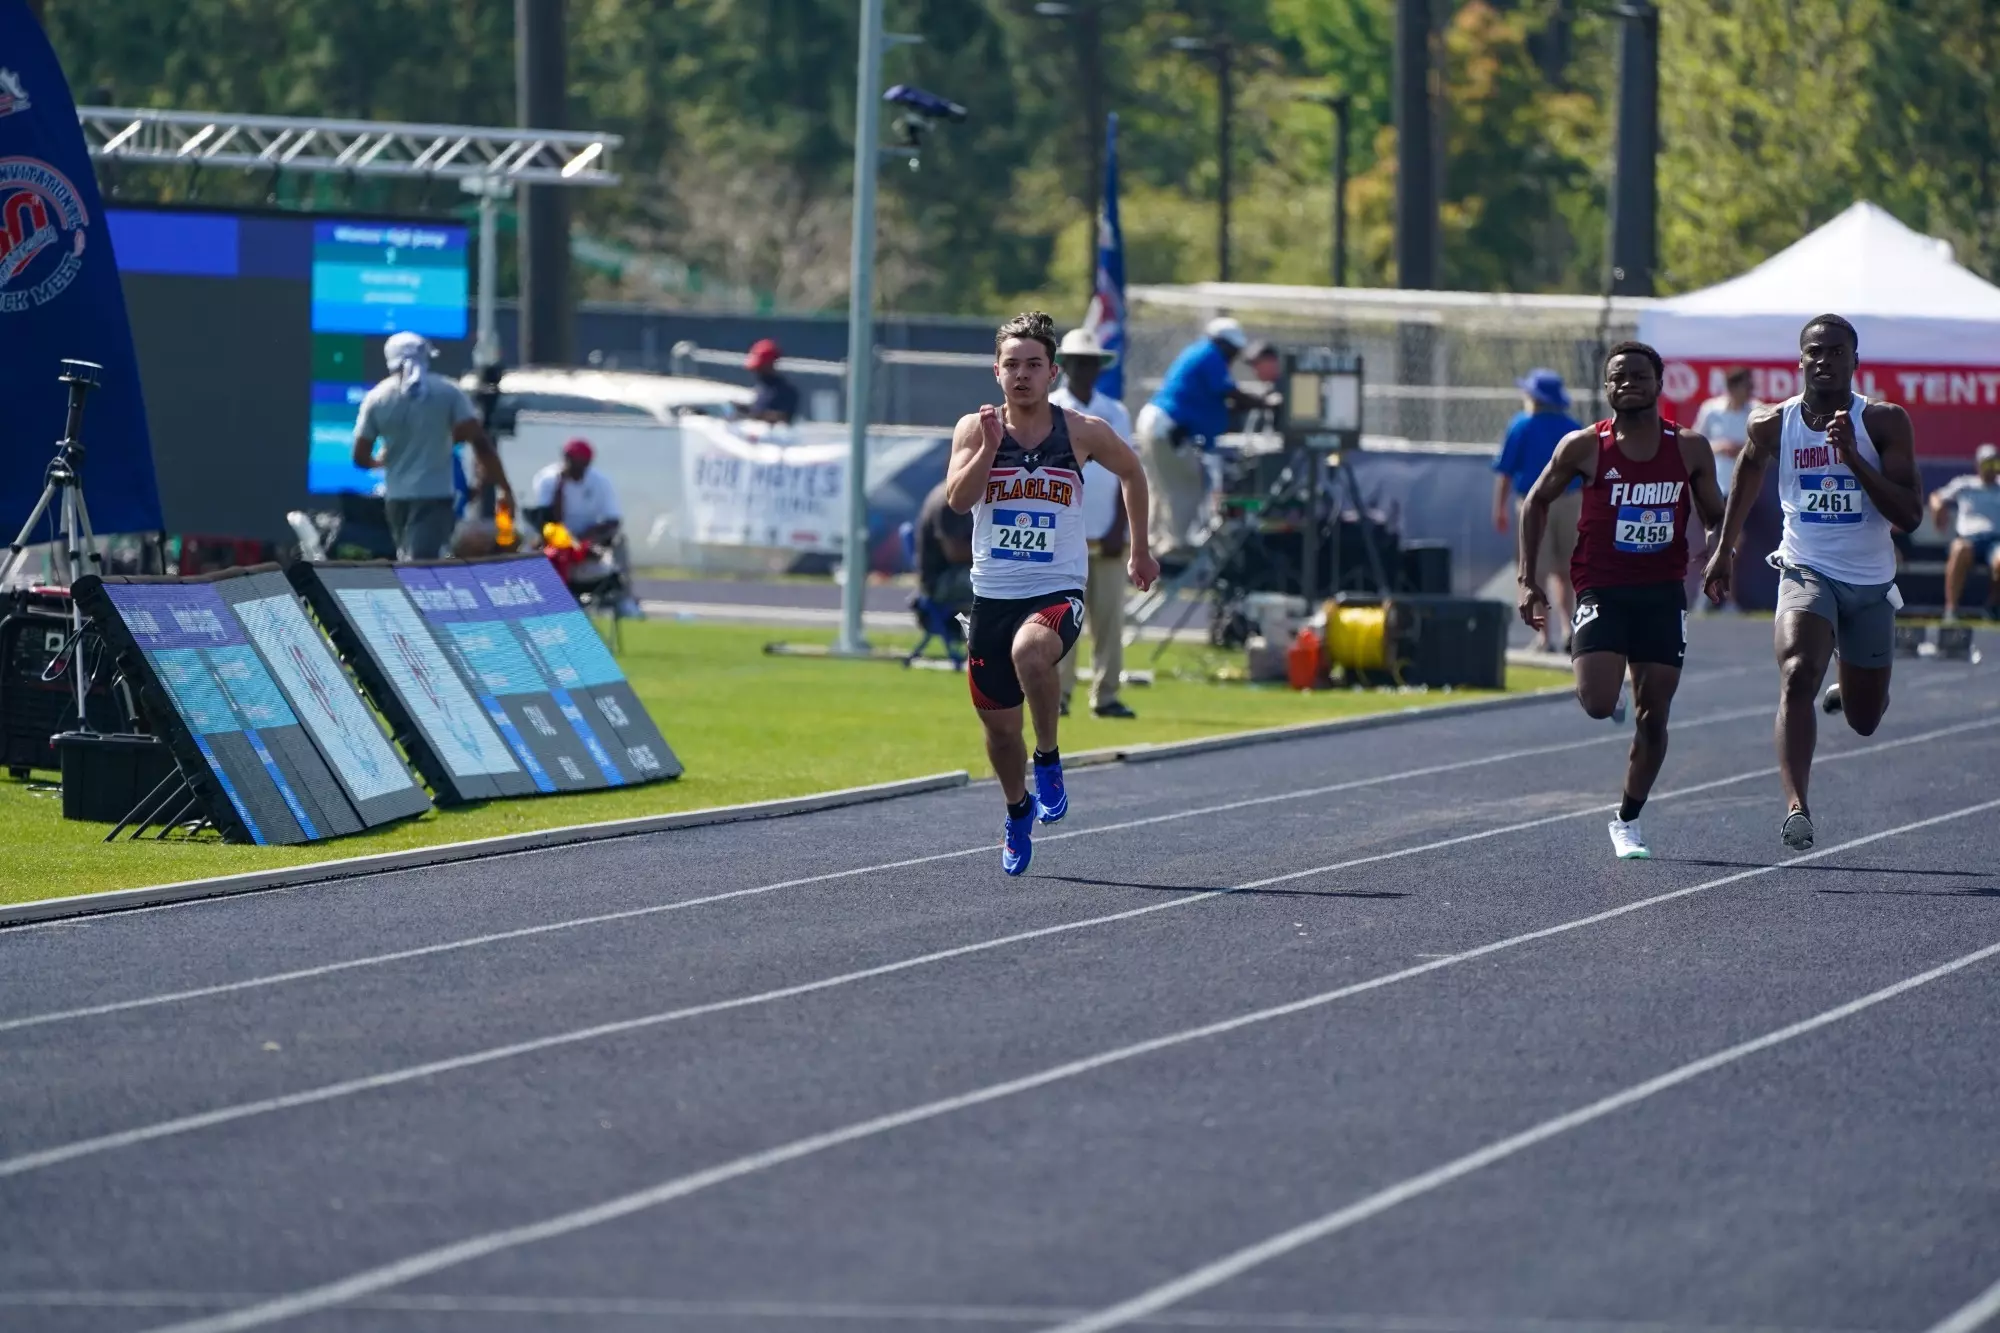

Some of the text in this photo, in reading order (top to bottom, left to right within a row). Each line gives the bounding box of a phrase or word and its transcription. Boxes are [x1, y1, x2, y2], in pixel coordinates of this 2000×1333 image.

[1896, 371, 2000, 405] TENT
[1794, 445, 1830, 469] FLORIDA
[985, 478, 1073, 507] FLAGLER
[1610, 481, 1684, 506] FLORIDA
[1807, 493, 1853, 513] 2461
[999, 528, 1047, 551] 2424
[1623, 524, 1668, 543] 2459
